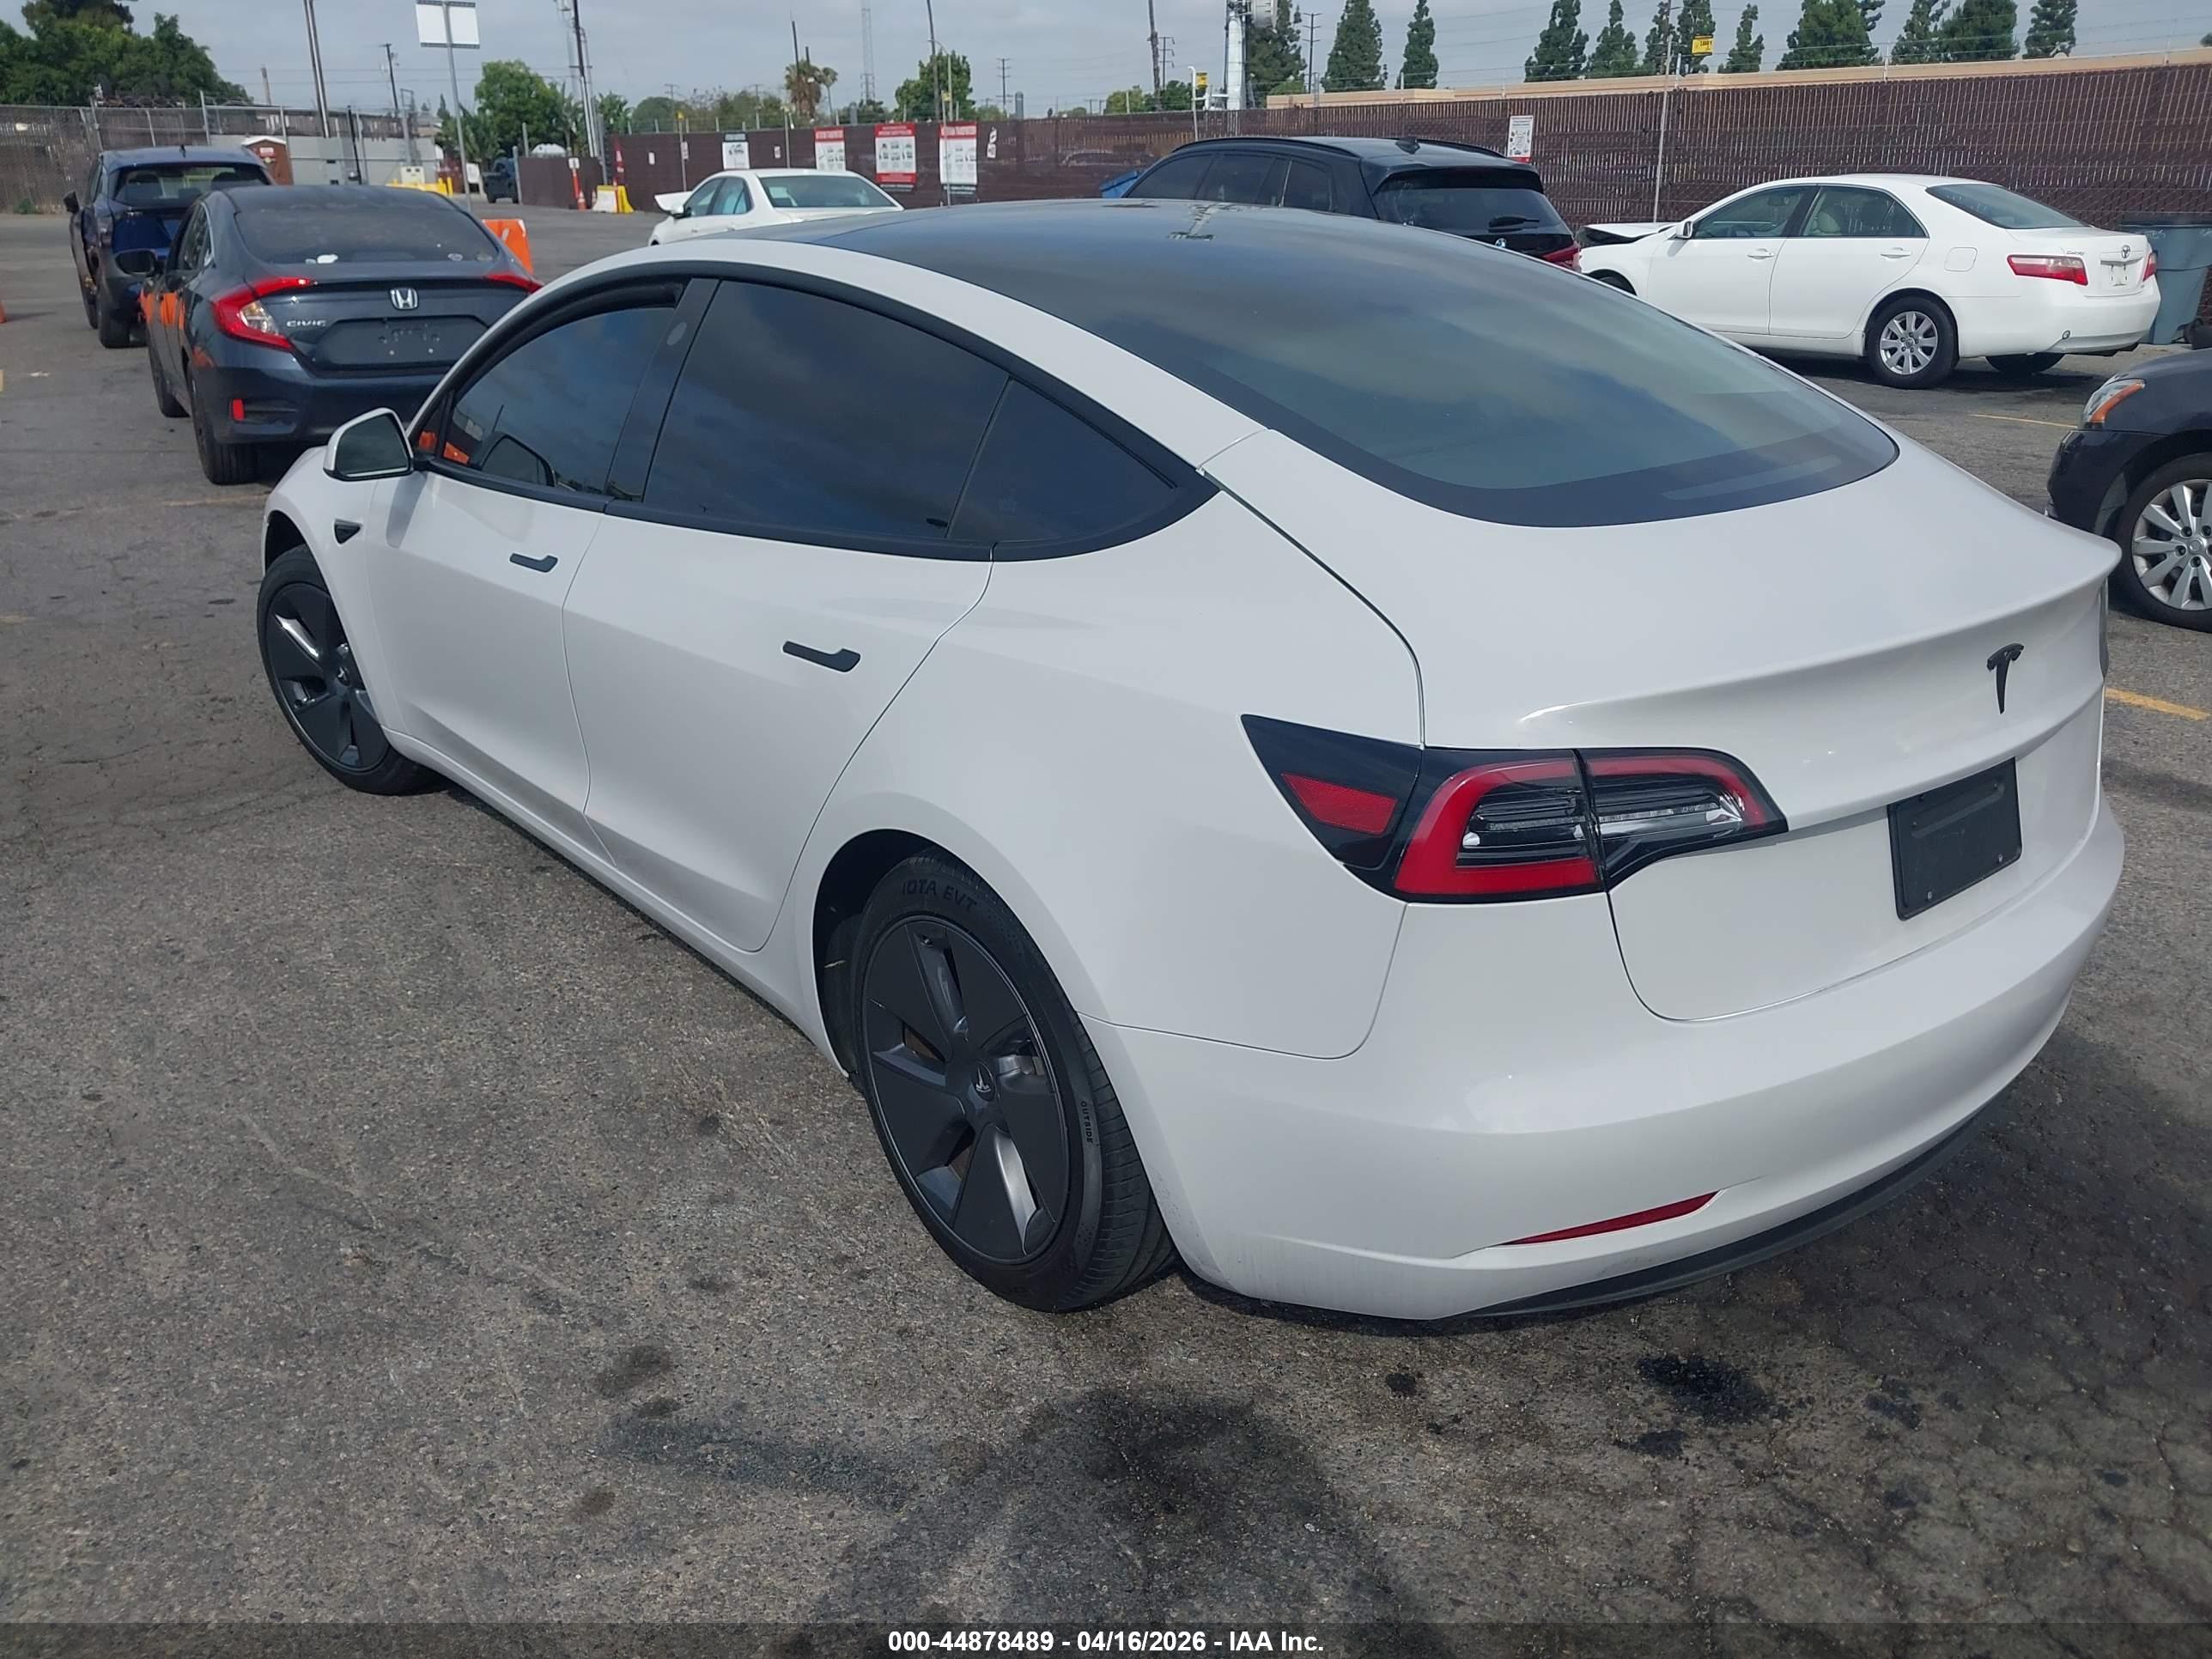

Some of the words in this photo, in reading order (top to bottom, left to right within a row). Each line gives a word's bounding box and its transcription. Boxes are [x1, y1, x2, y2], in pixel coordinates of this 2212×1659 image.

[902, 878, 937, 896] IOTA
[944, 885, 977, 911] EVT
[1080, 1101, 1093, 1143] OUTSIDE
